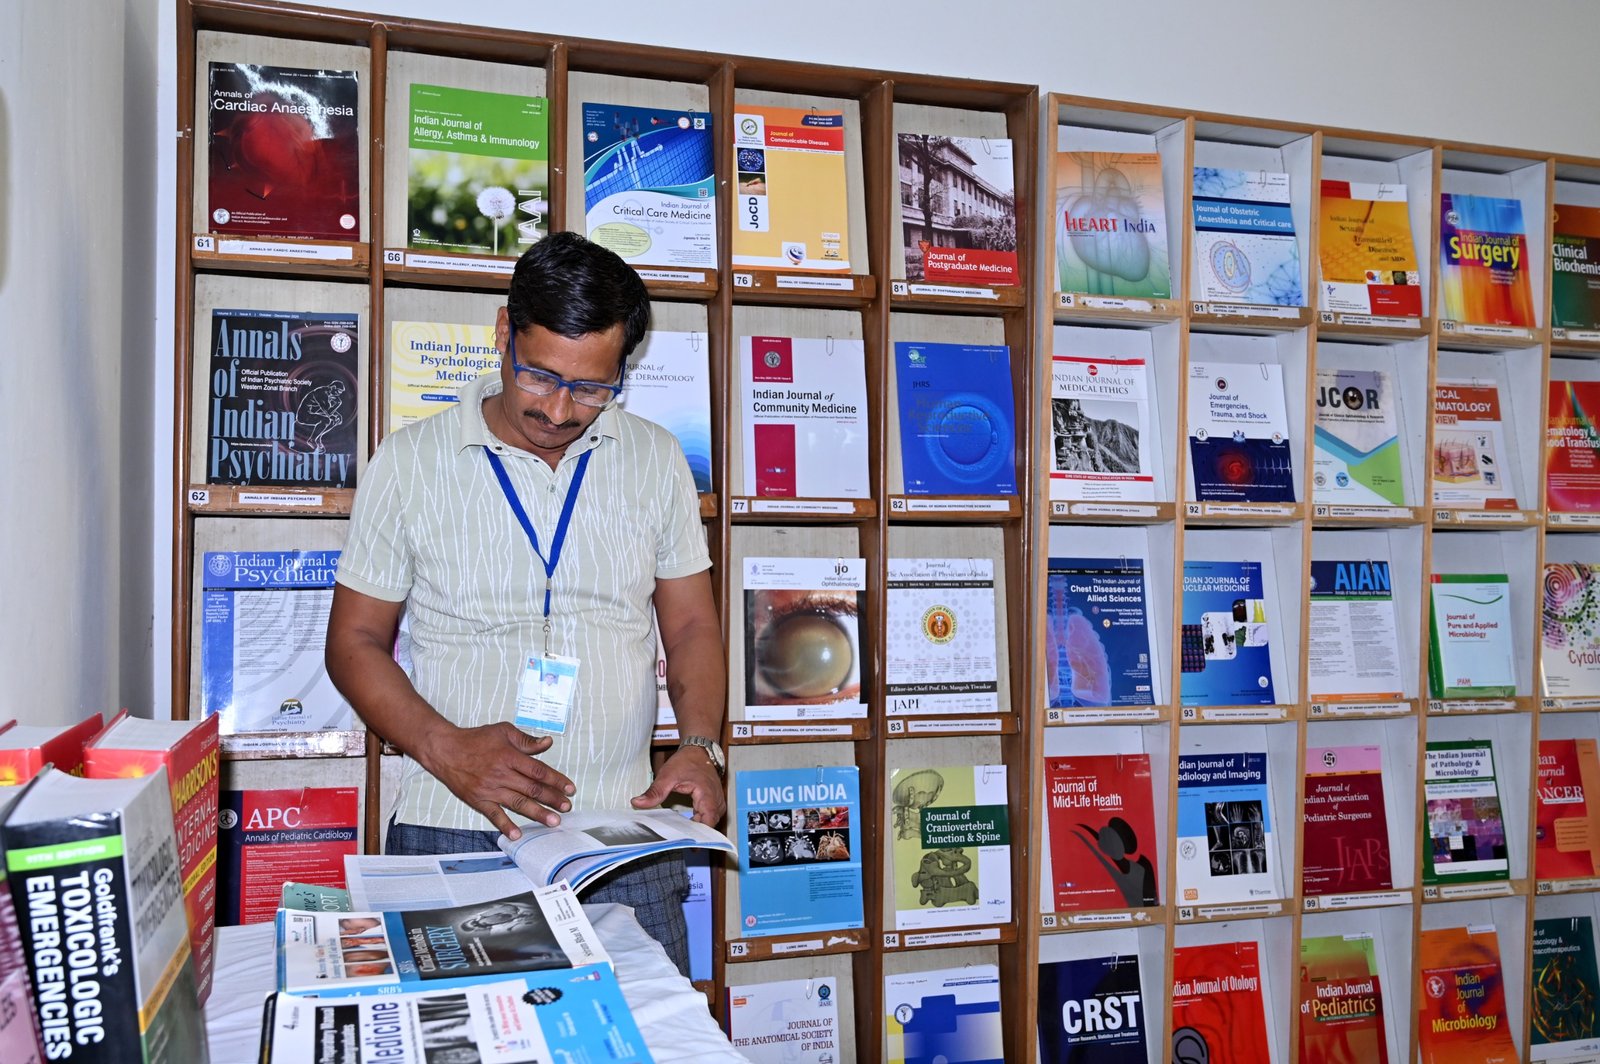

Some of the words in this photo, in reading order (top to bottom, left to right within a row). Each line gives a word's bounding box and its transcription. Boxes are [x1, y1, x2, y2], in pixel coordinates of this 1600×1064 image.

[214, 89, 242, 98] Annals
[214, 99, 267, 113] Cardiac
[271, 102, 354, 116] Anaeshesia
[414, 115, 439, 125] Indian
[441, 118, 471, 129] Journal
[474, 122, 482, 130] of
[414, 127, 444, 139] Allergy,
[447, 130, 478, 142] Asthma
[480, 134, 487, 143] &
[489, 135, 539, 149] Immunology
[613, 206, 644, 216] Critical
[647, 208, 668, 218] Care
[671, 210, 711, 220] Medicine
[749, 197, 759, 229] JoCD
[1196, 205, 1220, 213] Journal
[1230, 208, 1259, 216] Obstetric
[1064, 210, 1118, 232] HEART
[1198, 215, 1238, 224] Anaesthesia
[1253, 219, 1276, 227] Critical
[197, 239, 210, 248] 61
[1460, 232, 1484, 243] Indian
[1484, 234, 1511, 246] Journal
[1512, 236, 1520, 246] of
[388, 253, 400, 261] 66
[928, 252, 956, 261] Journal
[1450, 236, 1520, 269] Surgery
[1552, 244, 1587, 259] Clinical
[928, 261, 977, 271] Postgraduate
[979, 264, 1012, 273] Medicine
[1554, 258, 1600, 275] Biochemis
[214, 319, 302, 361] Annals
[420, 355, 501, 370] Psychologica
[214, 358, 240, 398] of
[260, 369, 288, 377] Publication
[636, 374, 694, 382] DERMATOLOGY
[264, 377, 293, 385] Psychiatric
[1086, 376, 1122, 385] JOURNAL
[1124, 378, 1135, 386] OF
[753, 389, 784, 399] Indian
[786, 390, 821, 400] Journal
[824, 393, 835, 402] of
[1060, 384, 1097, 392] MEDICAL
[1100, 386, 1129, 394] ETHICS
[753, 402, 810, 414] Community
[812, 404, 856, 414] Medicine
[1210, 402, 1250, 410] Emergencies,
[211, 398, 296, 440] Indian
[210, 438, 351, 488] Psychiatry
[192, 492, 205, 501] 62
[234, 554, 275, 567] Indian
[1335, 563, 1391, 590] AIAN
[1071, 585, 1092, 593] Chest
[1093, 585, 1125, 593] Diseases
[892, 699, 919, 712] JAPI
[1461, 751, 1486, 759] Journal
[1440, 760, 1473, 768] Pathology
[1435, 769, 1479, 777] Microbiology
[173, 749, 217, 814] HARRISON'S
[1052, 781, 1086, 793] Journal
[1088, 780, 1097, 792] of
[747, 786, 794, 805] LUNG
[799, 784, 847, 802] INDIA
[1537, 786, 1584, 799] ANCER
[1054, 796, 1090, 808] Mid-Life
[1093, 794, 1122, 806] Health
[246, 807, 301, 829] APC
[926, 811, 959, 821] Journal
[961, 810, 971, 819] of
[1338, 812, 1372, 822] Surgeons
[926, 820, 994, 832] Craniovertebral
[245, 834, 270, 842] Annals
[272, 832, 280, 841] of
[280, 832, 312, 841] Pediatric
[314, 830, 353, 840] Cardiology
[926, 833, 965, 844] Junction
[967, 833, 975, 842] &
[976, 832, 1000, 843] Spine
[94, 868, 121, 977] Goldfrank's
[1044, 917, 1054, 925] 89
[426, 926, 470, 971] SURGERY
[732, 945, 743, 954] 79
[60, 870, 105, 1045] TOXICOLOGIC
[26, 875, 72, 1060] EMERGENCIES
[1193, 977, 1220, 994] Journal
[1221, 976, 1229, 992] of
[1230, 975, 1257, 991] Otology
[1455, 974, 1480, 986] Indian
[1317, 984, 1343, 998] Indian
[1345, 980, 1374, 995] Journal
[1456, 986, 1484, 1000] Journal
[1301, 1000, 1310, 1013] of
[1312, 996, 1376, 1017] Pediatrics
[1458, 1001, 1466, 1013] of
[1062, 995, 1140, 1034] CRST
[787, 1019, 821, 1030] JOURNAL
[823, 1018, 833, 1026] OF
[1432, 1015, 1497, 1033] Microbiology
[734, 1039, 749, 1047] THE
[751, 1032, 800, 1045] ANATOMICAL
[801, 1029, 833, 1040] SOCIETY
[801, 1043, 811, 1051] OF
[813, 1041, 834, 1050] INDIA
